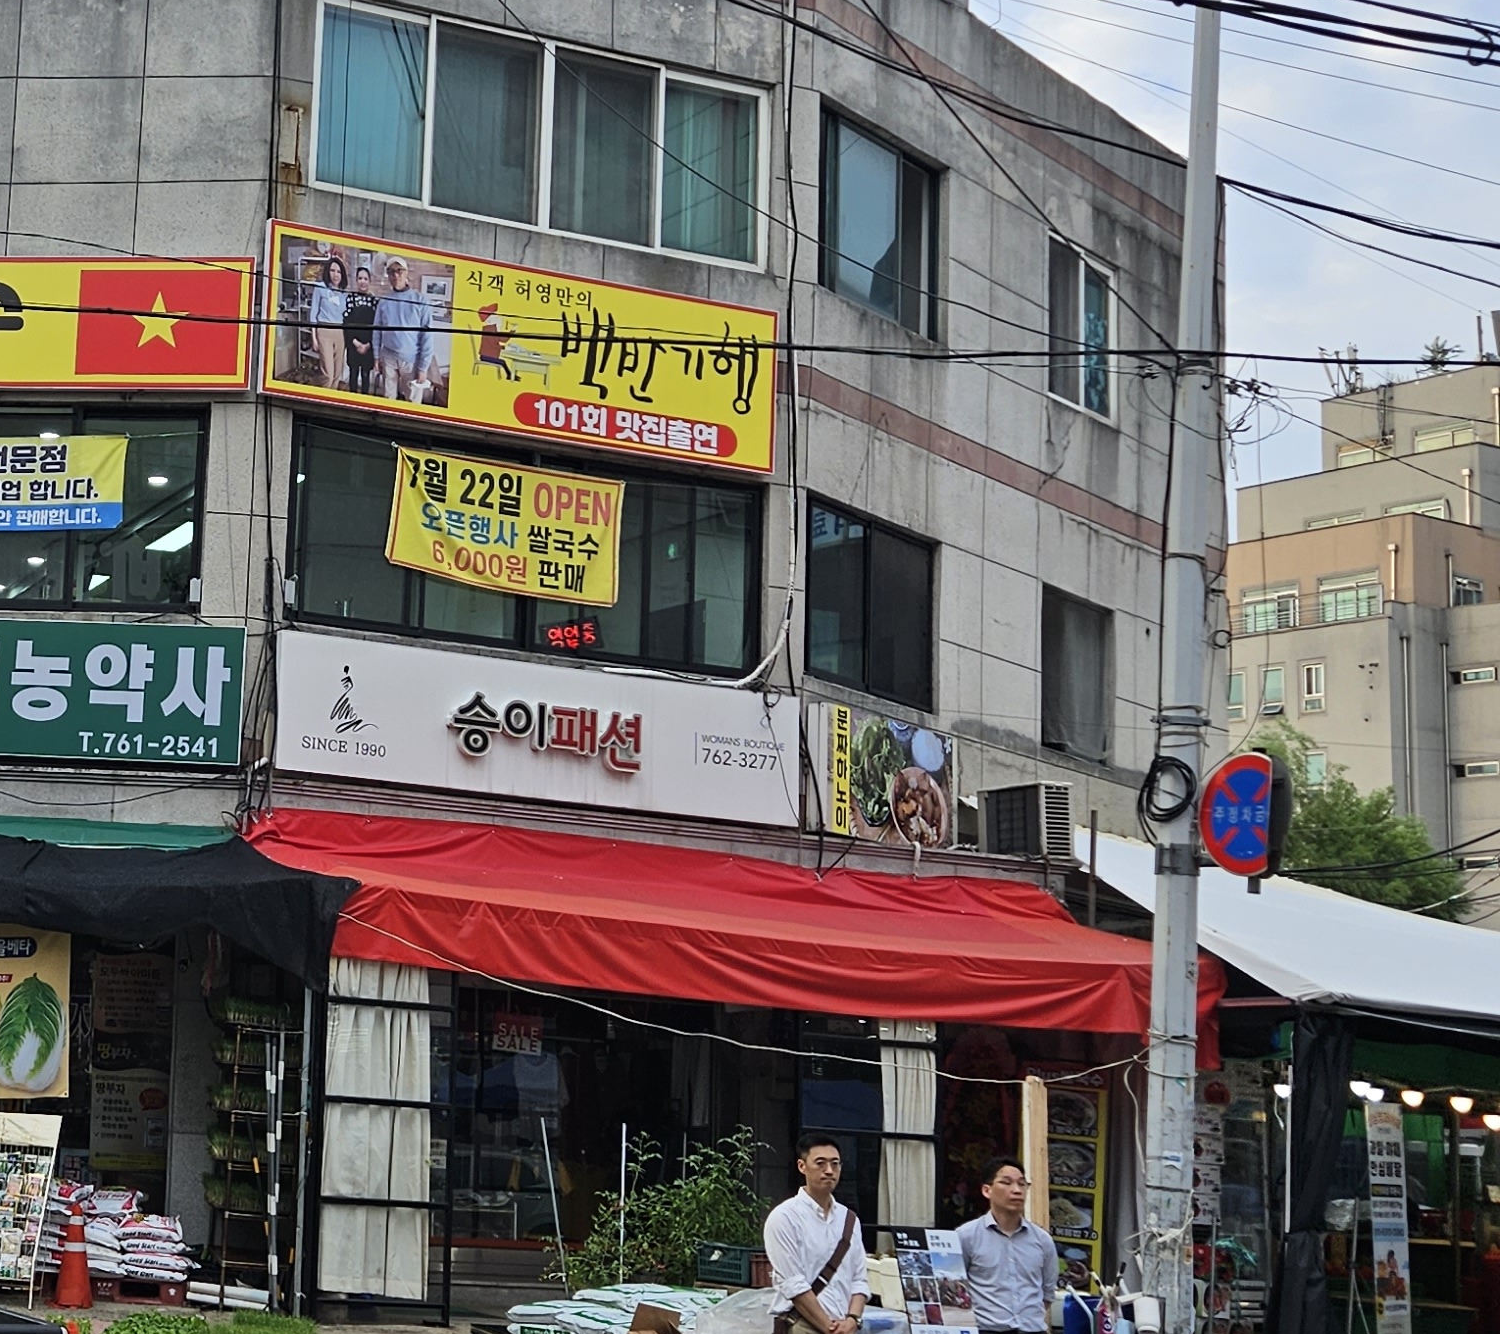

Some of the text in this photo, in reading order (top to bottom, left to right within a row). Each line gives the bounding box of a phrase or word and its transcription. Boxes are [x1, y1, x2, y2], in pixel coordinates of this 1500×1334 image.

[466, 270, 593, 312] 식객 허영만의
[533, 398, 719, 456] 101회 맛집출연
[29, 478, 100, 500] 합니다.
[459, 468, 522, 518] 22일
[534, 482, 612, 527] OPEN
[15, 507, 102, 527] 판매합니다.
[420, 501, 600, 561] 오픈행사 쌀국수
[432, 540, 586, 594] 6,000원 판매
[78, 731, 219, 758] T.761-2541
[447, 691, 644, 774] 승이패션
[301, 736, 387, 758] SINCE 1990
[743, 739, 786, 753] BOUTIQUE
[701, 748, 778, 772] 762-3277
[497, 1035, 538, 1053] SALE
[498, 1022, 539, 1041] SALE
